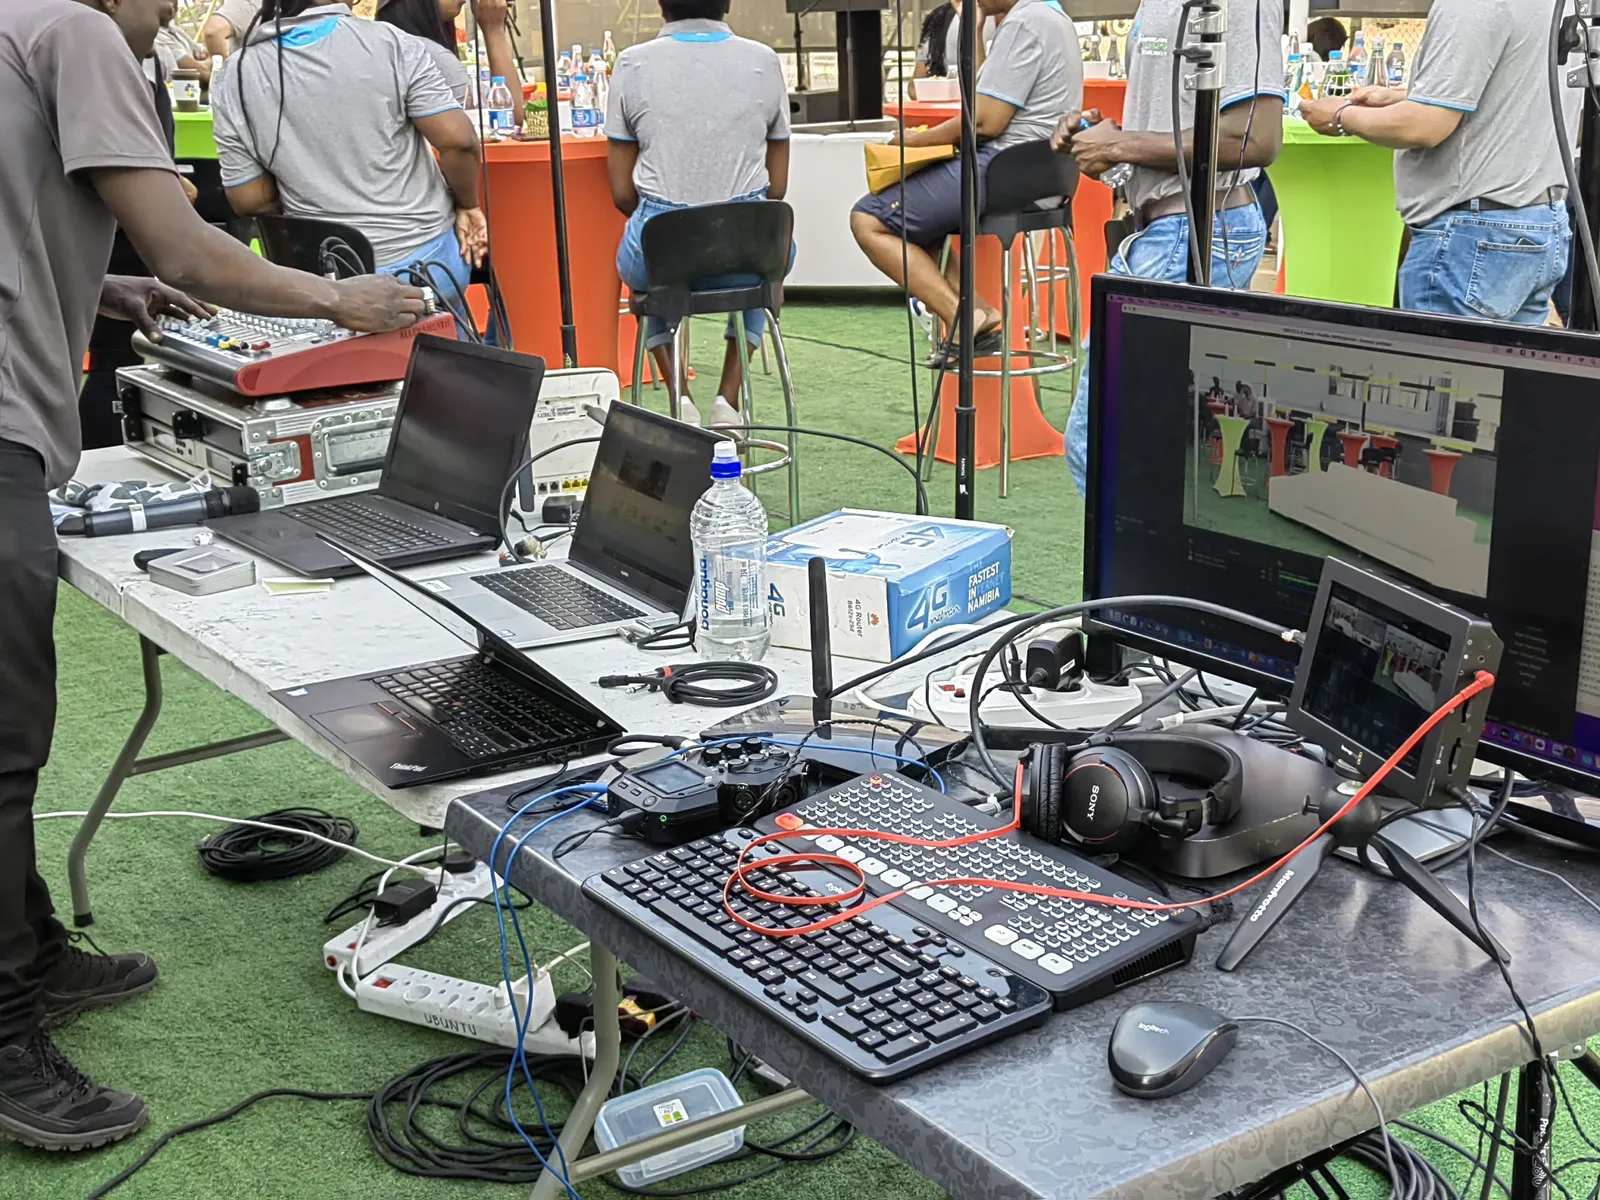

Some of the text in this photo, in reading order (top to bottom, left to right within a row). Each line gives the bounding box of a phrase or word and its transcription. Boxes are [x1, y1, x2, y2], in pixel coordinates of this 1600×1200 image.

[969, 562, 1000, 588] FASTEST
[714, 579, 731, 615] pump
[767, 582, 785, 617] 4G
[855, 598, 861, 612] 4G
[906, 578, 950, 630] 4G
[967, 587, 1001, 613] NAMIBIA
[1086, 785, 1100, 821] SONY
[1250, 869, 1295, 922] Manfrotto
[424, 1012, 477, 1036] UBUNTU
[1138, 1022, 1170, 1036] logitech
